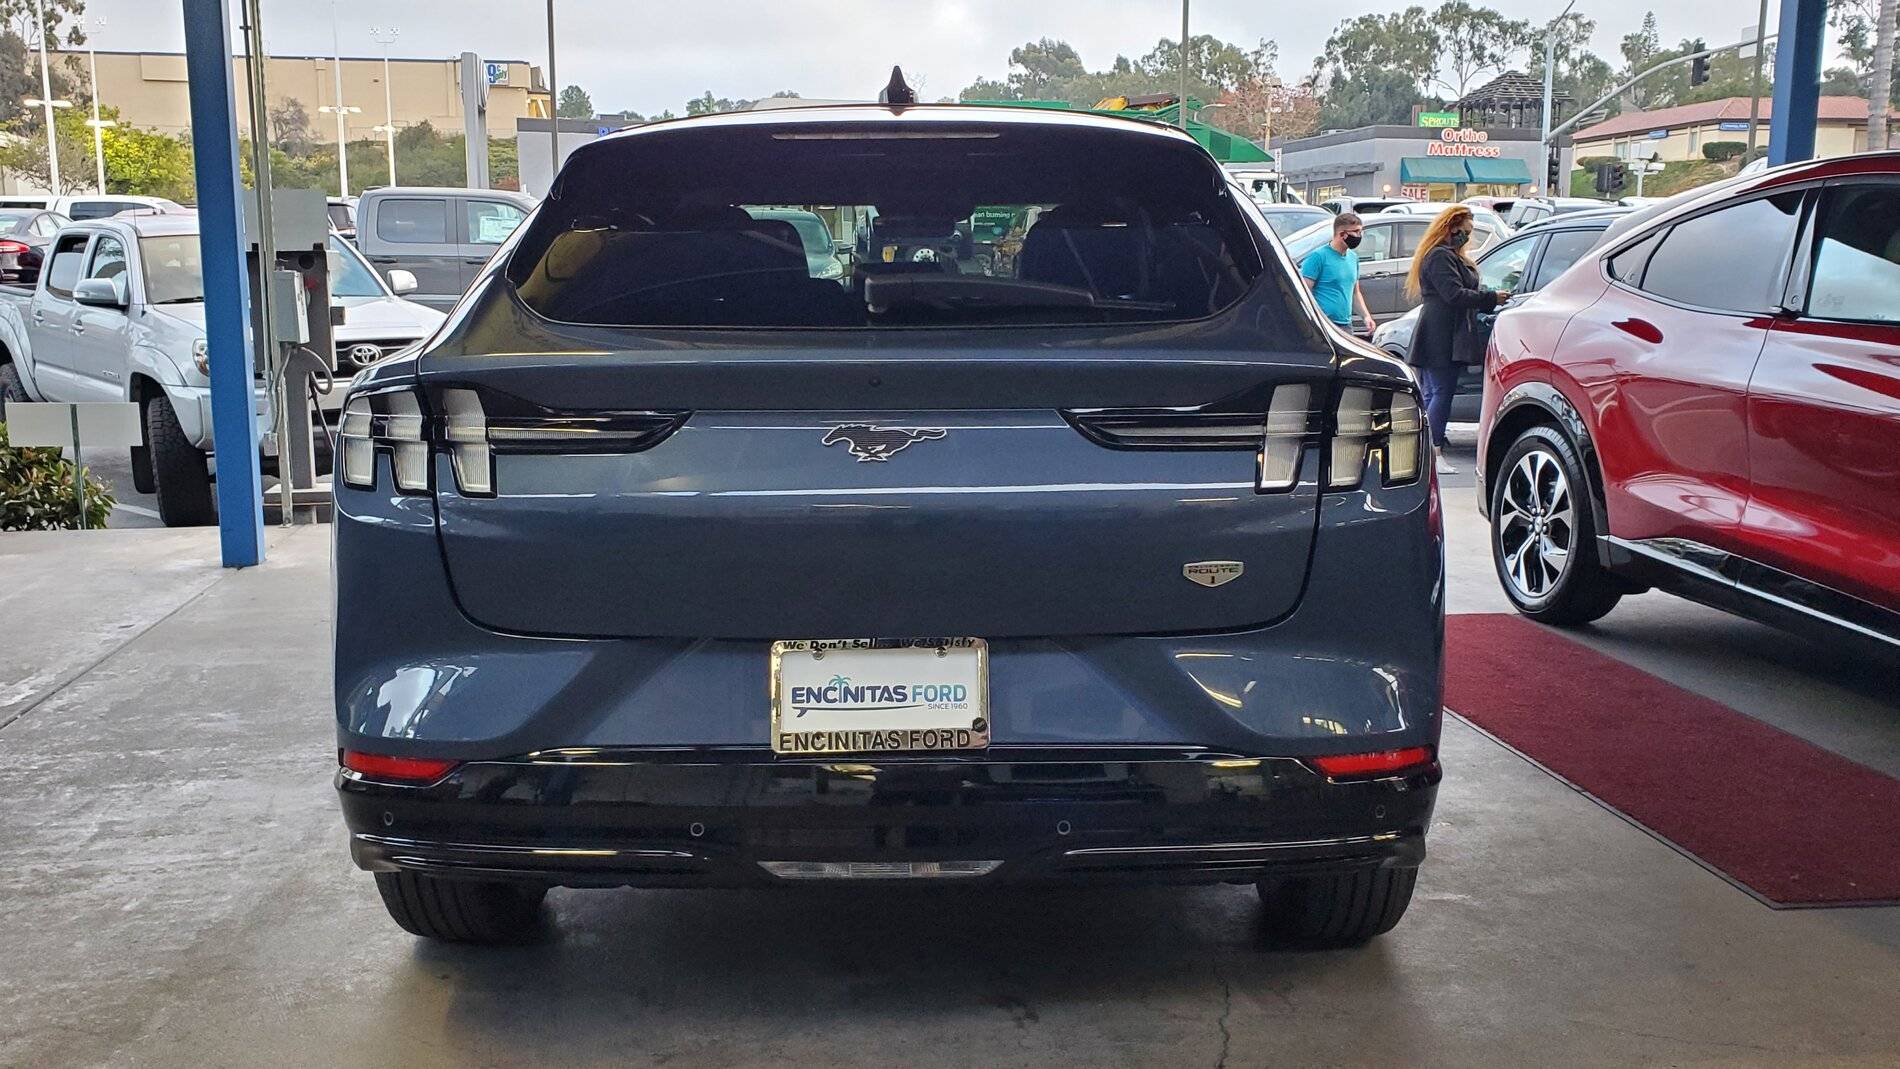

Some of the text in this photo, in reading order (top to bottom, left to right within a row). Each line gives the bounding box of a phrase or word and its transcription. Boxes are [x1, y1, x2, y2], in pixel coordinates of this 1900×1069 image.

[1421, 116, 1460, 128] SPROUTS
[1441, 128, 1488, 142] Ortho
[1427, 142, 1500, 157] Mattress
[1401, 187, 1427, 200] SALE
[783, 641, 805, 650] We
[810, 640, 847, 649] Don't
[924, 637, 975, 648] Satisfy
[792, 684, 967, 704] ENCINITAS FORD
[780, 729, 971, 751] ENCINITAS FORD
